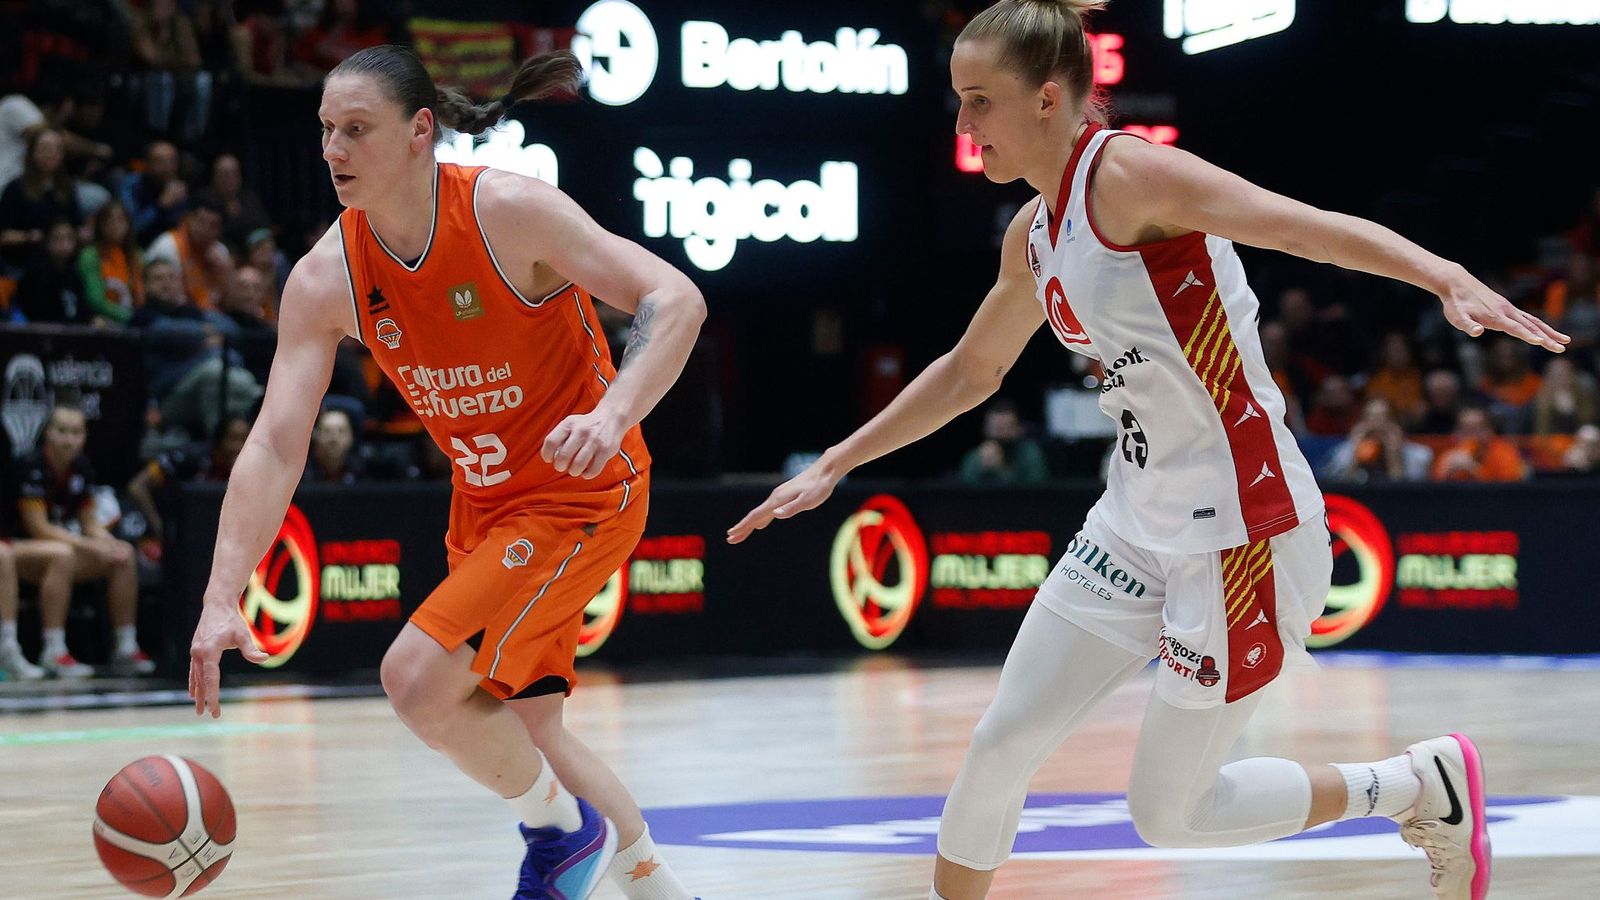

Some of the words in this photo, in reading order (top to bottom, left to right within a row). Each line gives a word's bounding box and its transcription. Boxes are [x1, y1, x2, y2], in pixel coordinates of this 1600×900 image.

[681, 20, 909, 94] Bertolín
[397, 364, 485, 391] Cultura
[486, 362, 512, 383] del
[408, 385, 524, 419] Esfuerzo
[450, 433, 513, 487] 22
[1060, 564, 1115, 601] HOTELES
